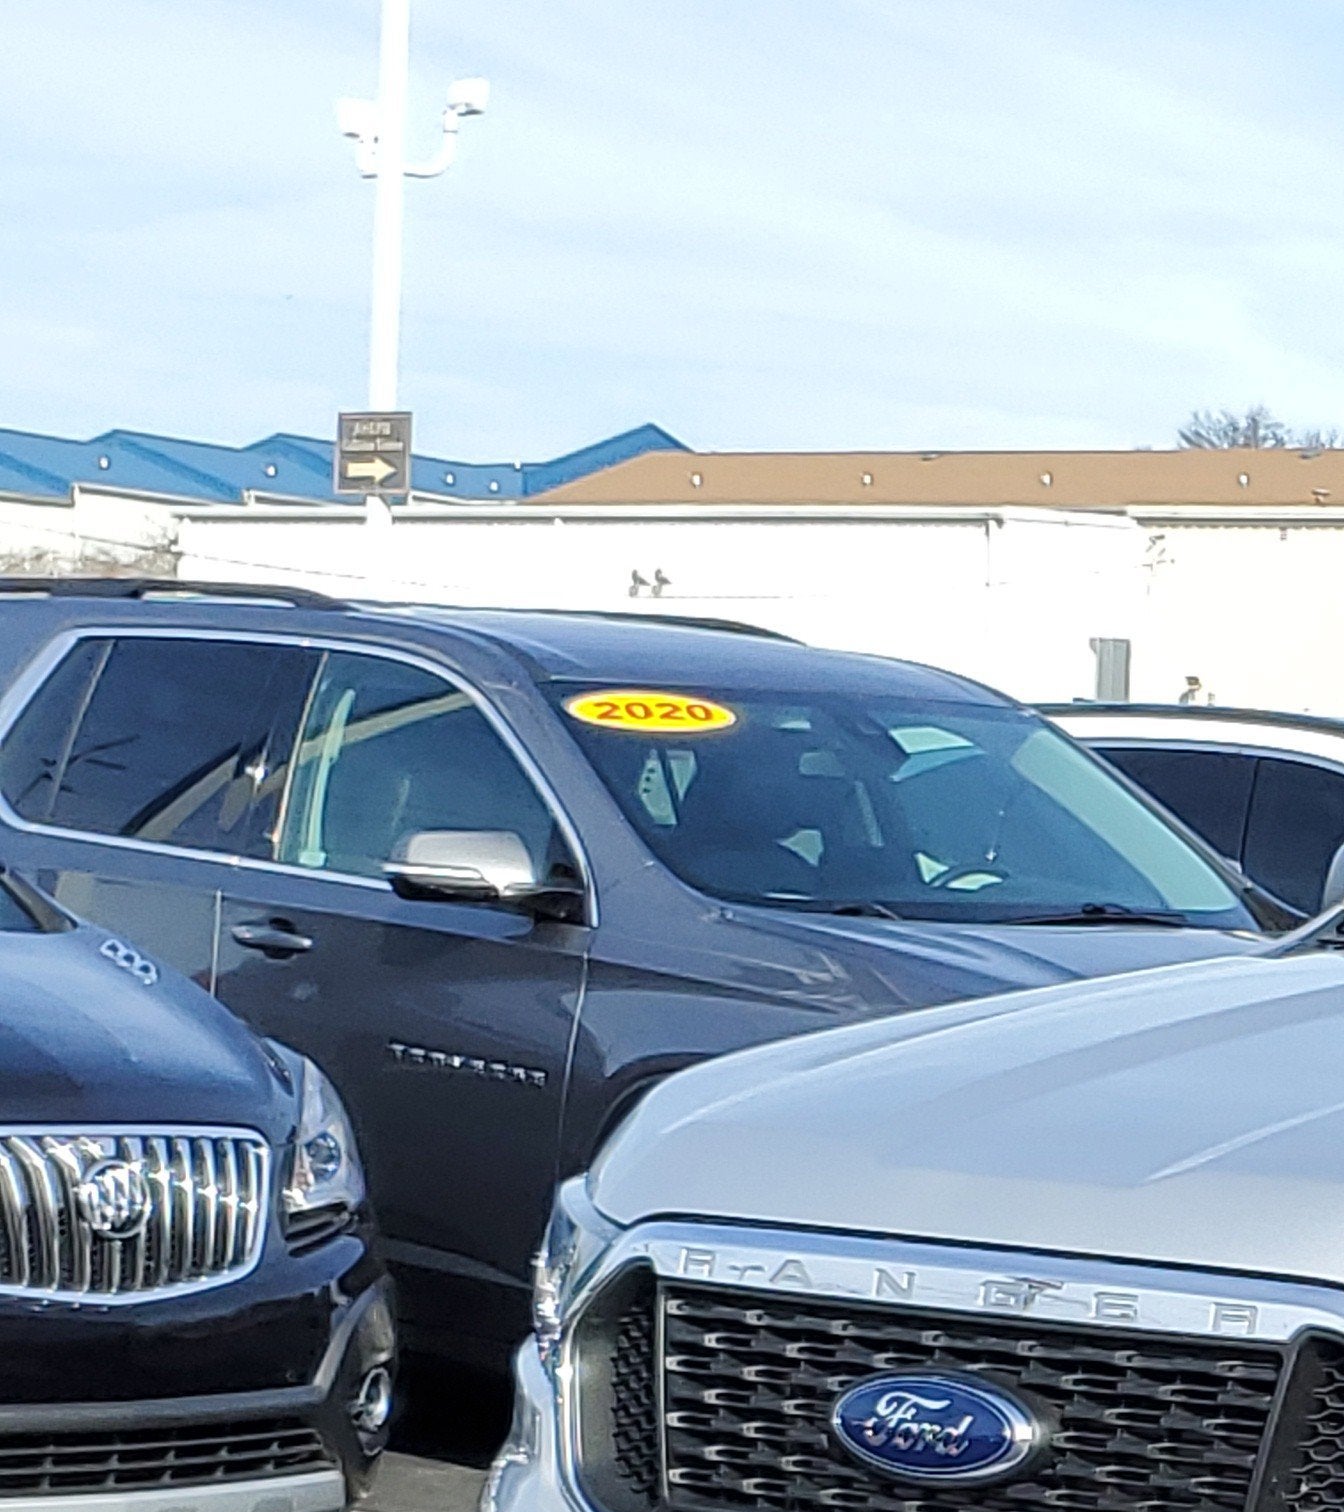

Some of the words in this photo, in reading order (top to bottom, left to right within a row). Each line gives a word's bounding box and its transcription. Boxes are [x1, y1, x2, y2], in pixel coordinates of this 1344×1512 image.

[594, 701, 714, 722] 2020
[678, 1246, 1258, 1336] RANGER
[863, 1390, 975, 1458] Ford
